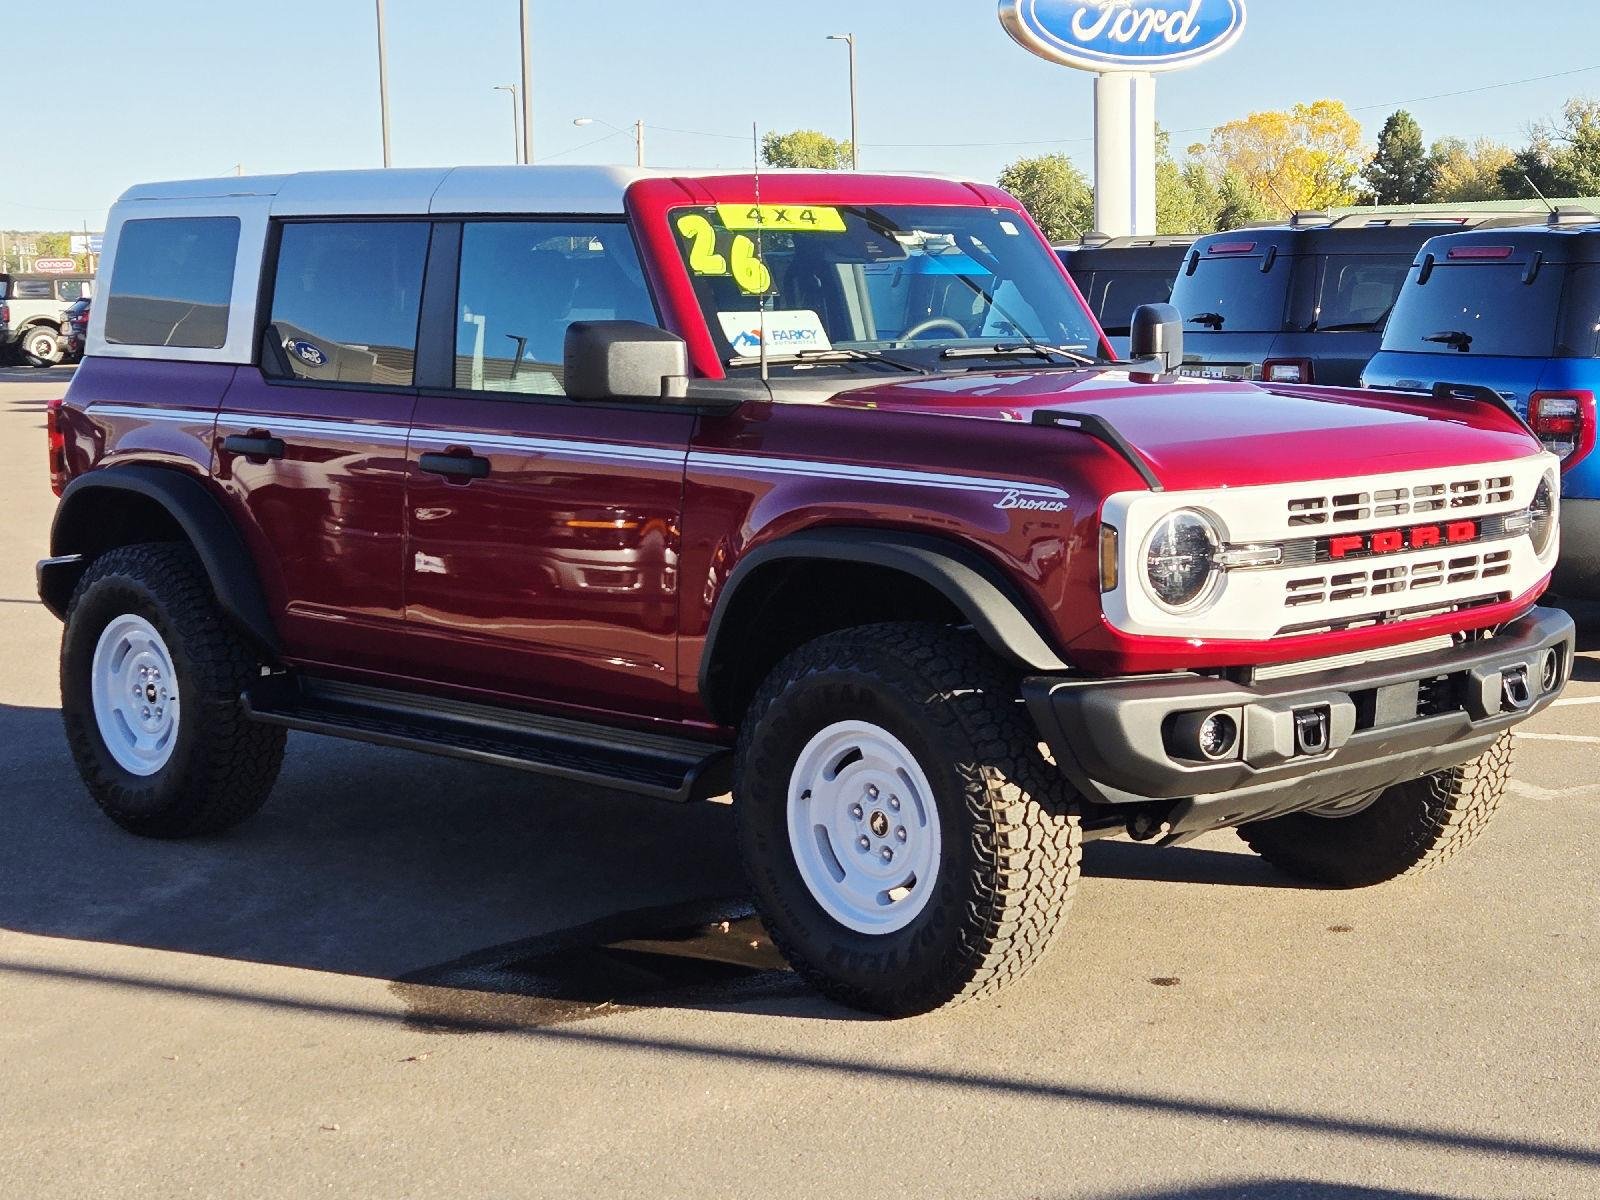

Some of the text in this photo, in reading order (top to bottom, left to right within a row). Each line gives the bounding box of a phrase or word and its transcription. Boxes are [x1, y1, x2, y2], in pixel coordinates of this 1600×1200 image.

[1071, 0, 1200, 43] Ford
[677, 214, 771, 294] 26
[992, 488, 1068, 512] Bronco
[1329, 520, 1476, 559] FORD
